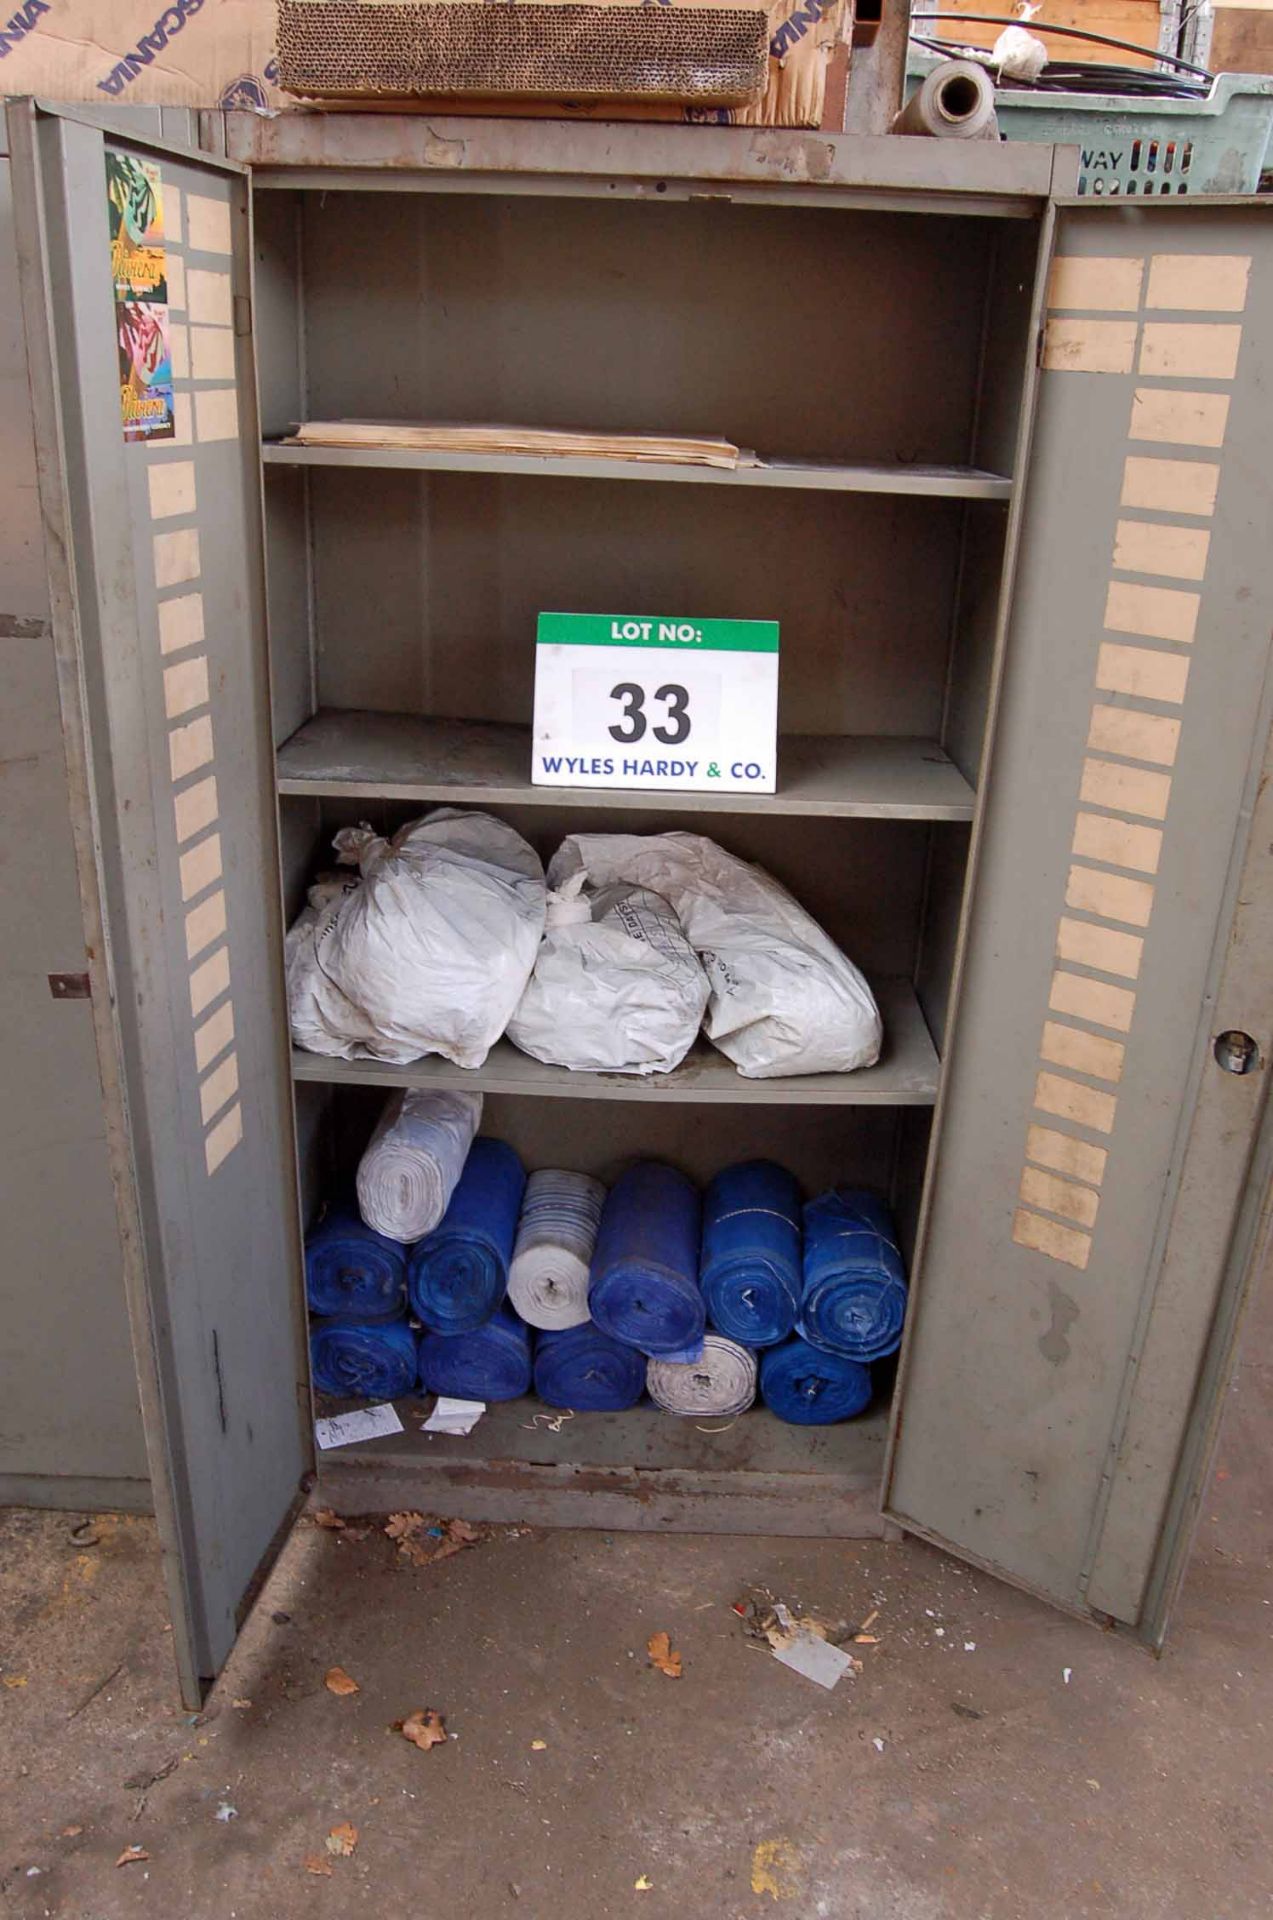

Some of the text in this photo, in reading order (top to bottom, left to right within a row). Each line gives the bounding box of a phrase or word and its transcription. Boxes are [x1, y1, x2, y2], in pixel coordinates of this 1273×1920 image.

[0, 0, 51, 58] NIA
[96, 0, 205, 95] SCANIA
[611, 622, 702, 642] LOT NO:
[608, 683, 692, 744] 33
[542, 757, 766, 780] WYLES HARDY & CO.
